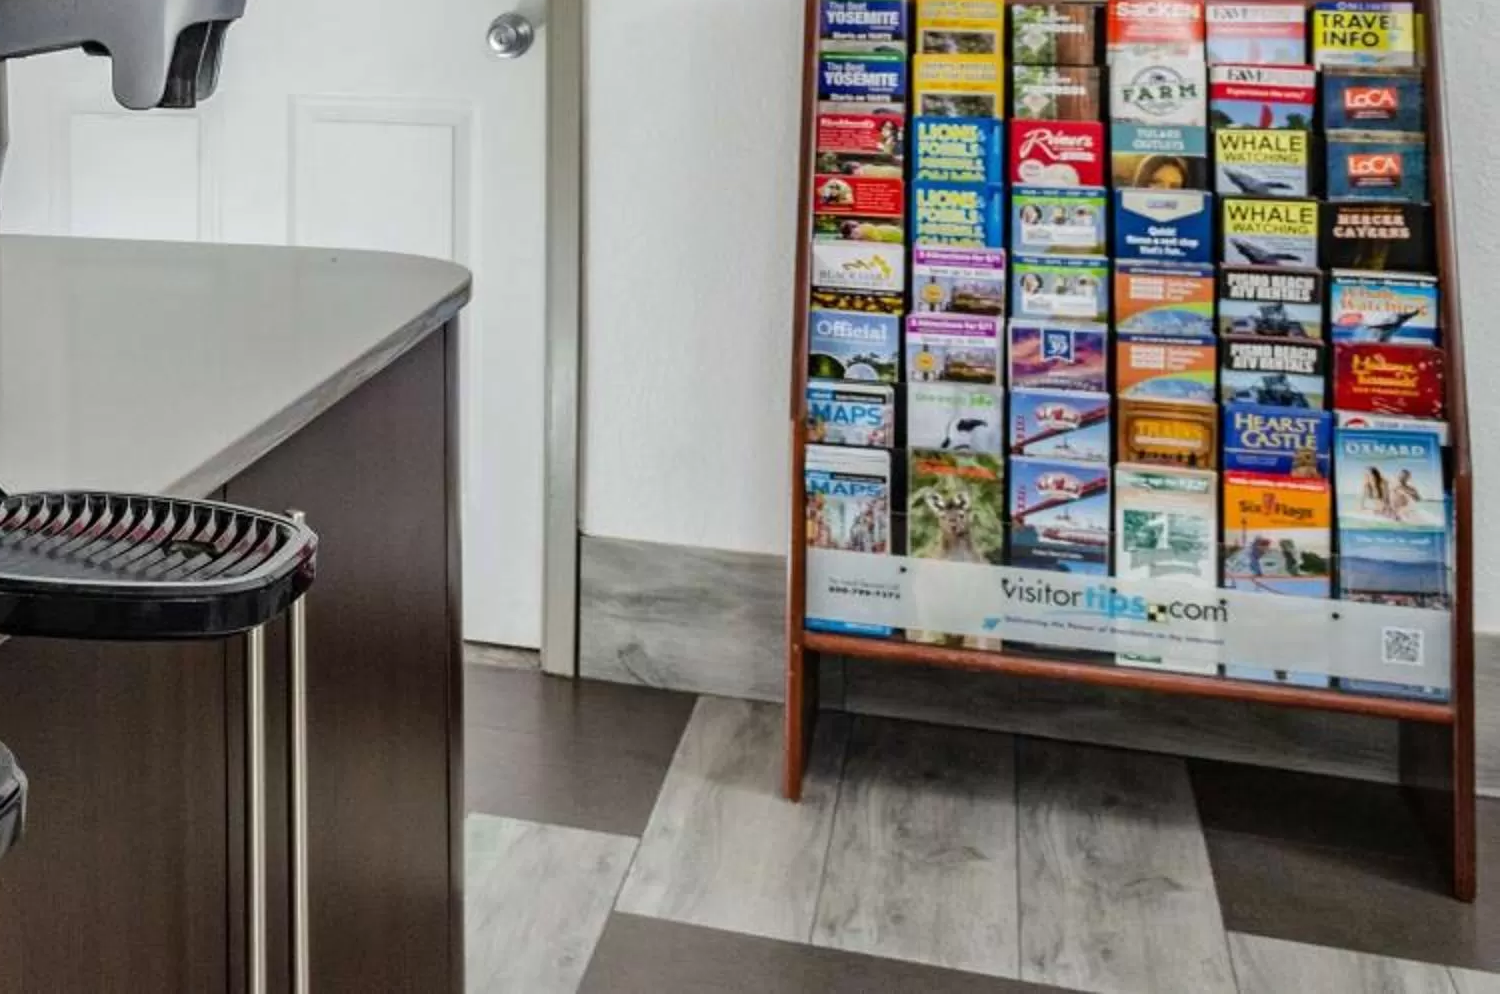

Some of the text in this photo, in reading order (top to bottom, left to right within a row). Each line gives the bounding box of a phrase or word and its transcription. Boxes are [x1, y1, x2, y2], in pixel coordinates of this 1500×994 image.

[826, 11, 900, 26] YOSEMITE
[1320, 13, 1404, 32] TRAVEL
[1322, 31, 1380, 47] INFO
[823, 72, 900, 86] YOSEMITE
[1122, 82, 1198, 104] FARM
[1219, 134, 1303, 153] WHALE
[1224, 152, 1299, 163] WATCHING
[1227, 205, 1314, 224] WHALE
[1232, 223, 1309, 235] WATCHING
[816, 320, 888, 342] Official
[811, 403, 882, 426] MAPS
[1234, 412, 1322, 434] HEARST
[1241, 429, 1318, 451] CASTLE
[1345, 443, 1425, 456] OXNARD
[811, 479, 881, 497] MAPS
